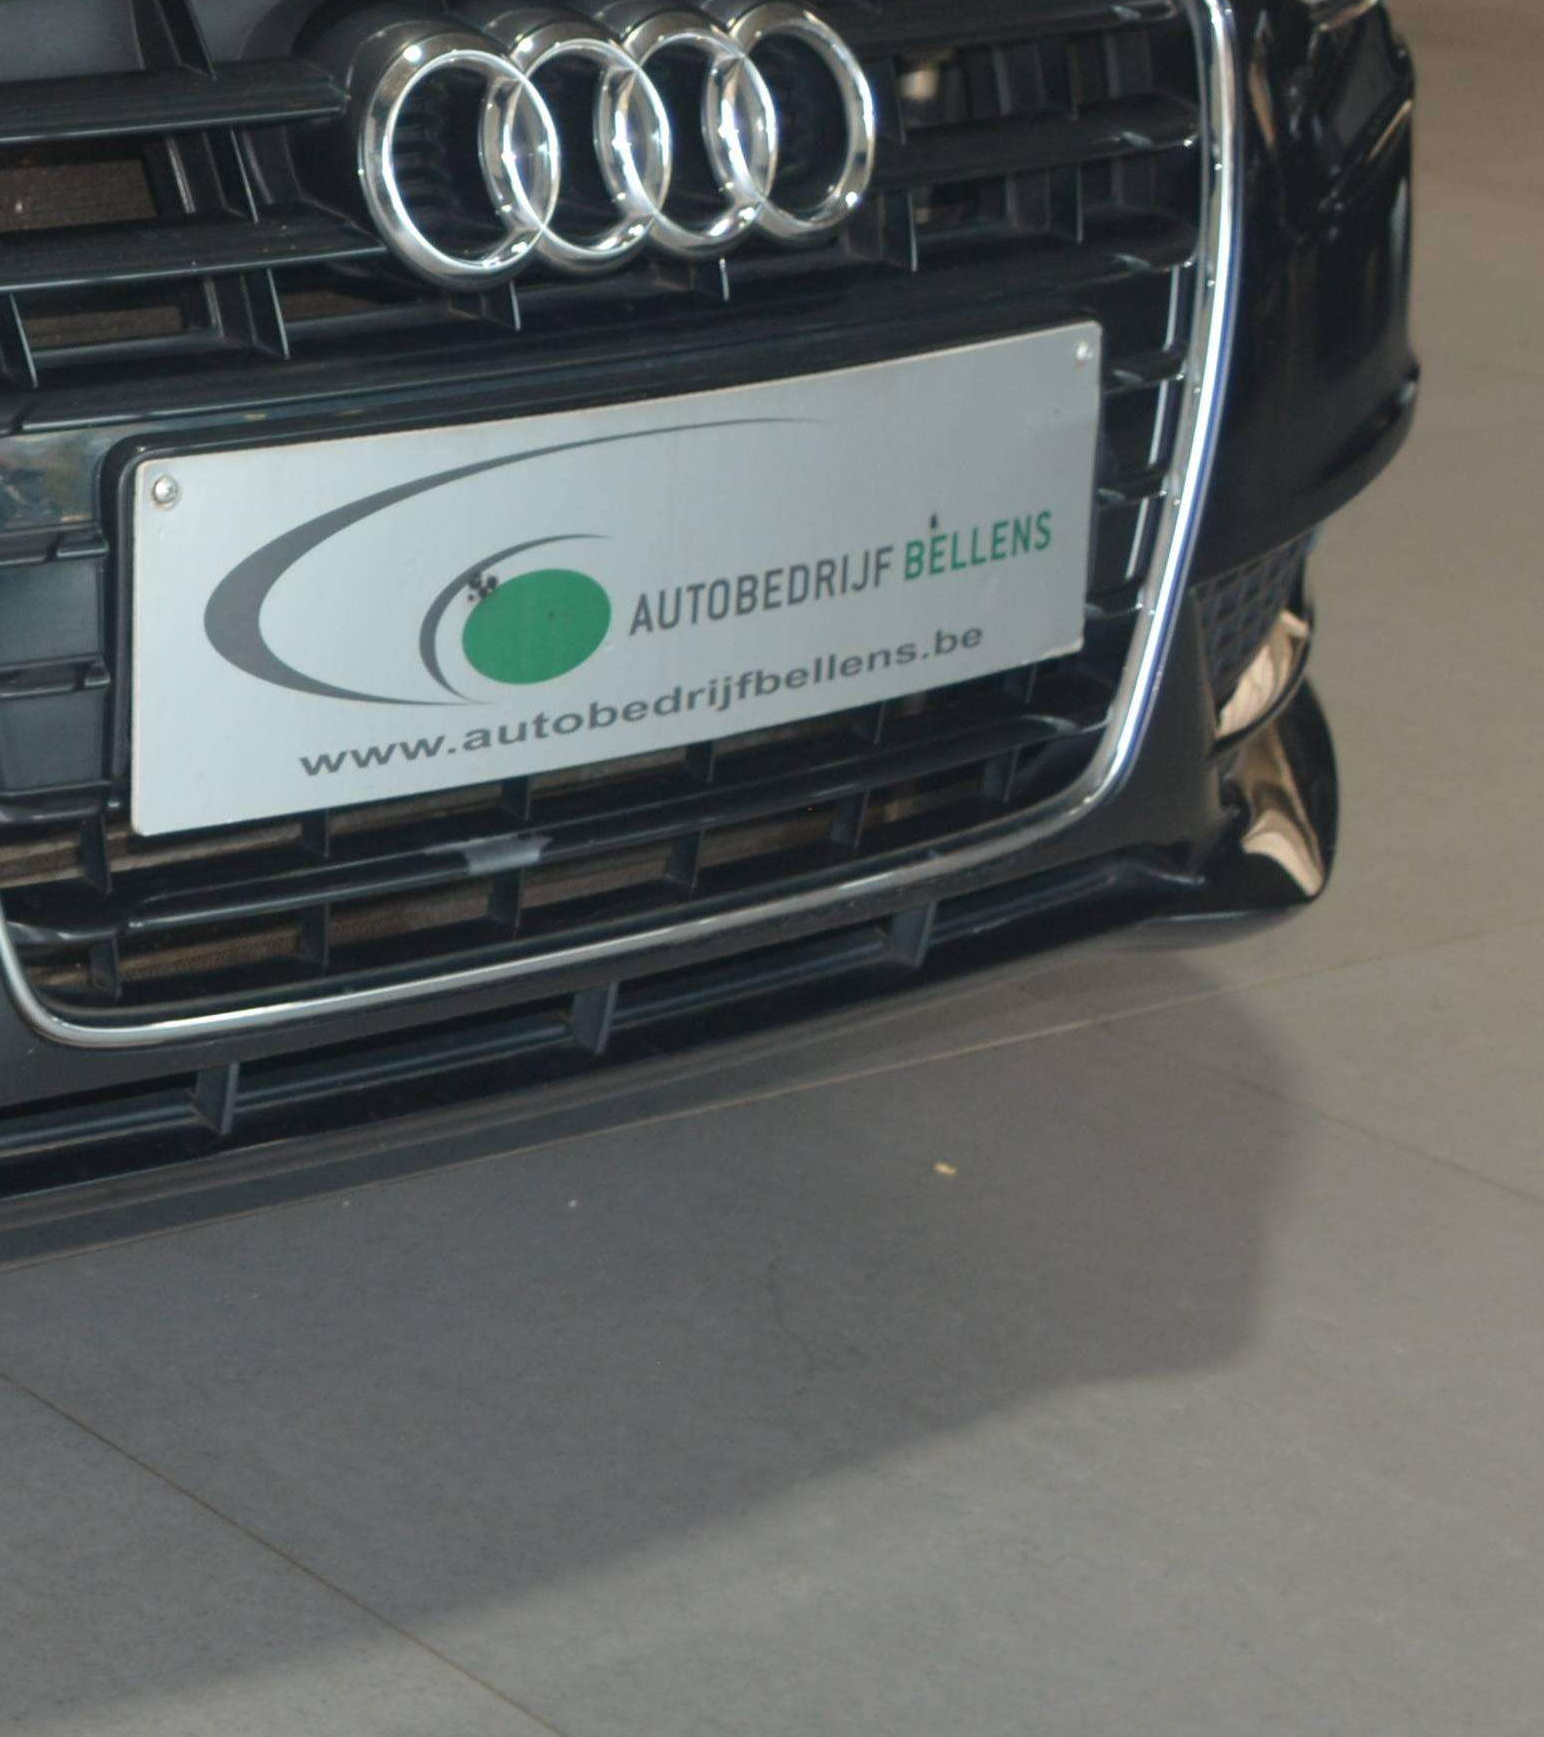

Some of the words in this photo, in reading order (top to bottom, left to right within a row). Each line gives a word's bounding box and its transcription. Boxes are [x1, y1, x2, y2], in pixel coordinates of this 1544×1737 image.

[628, 544, 895, 638] AUTOBEDRIJF
[901, 510, 1053, 581] BELLENS
[298, 621, 984, 778] www.autobedrijfbellens.be
